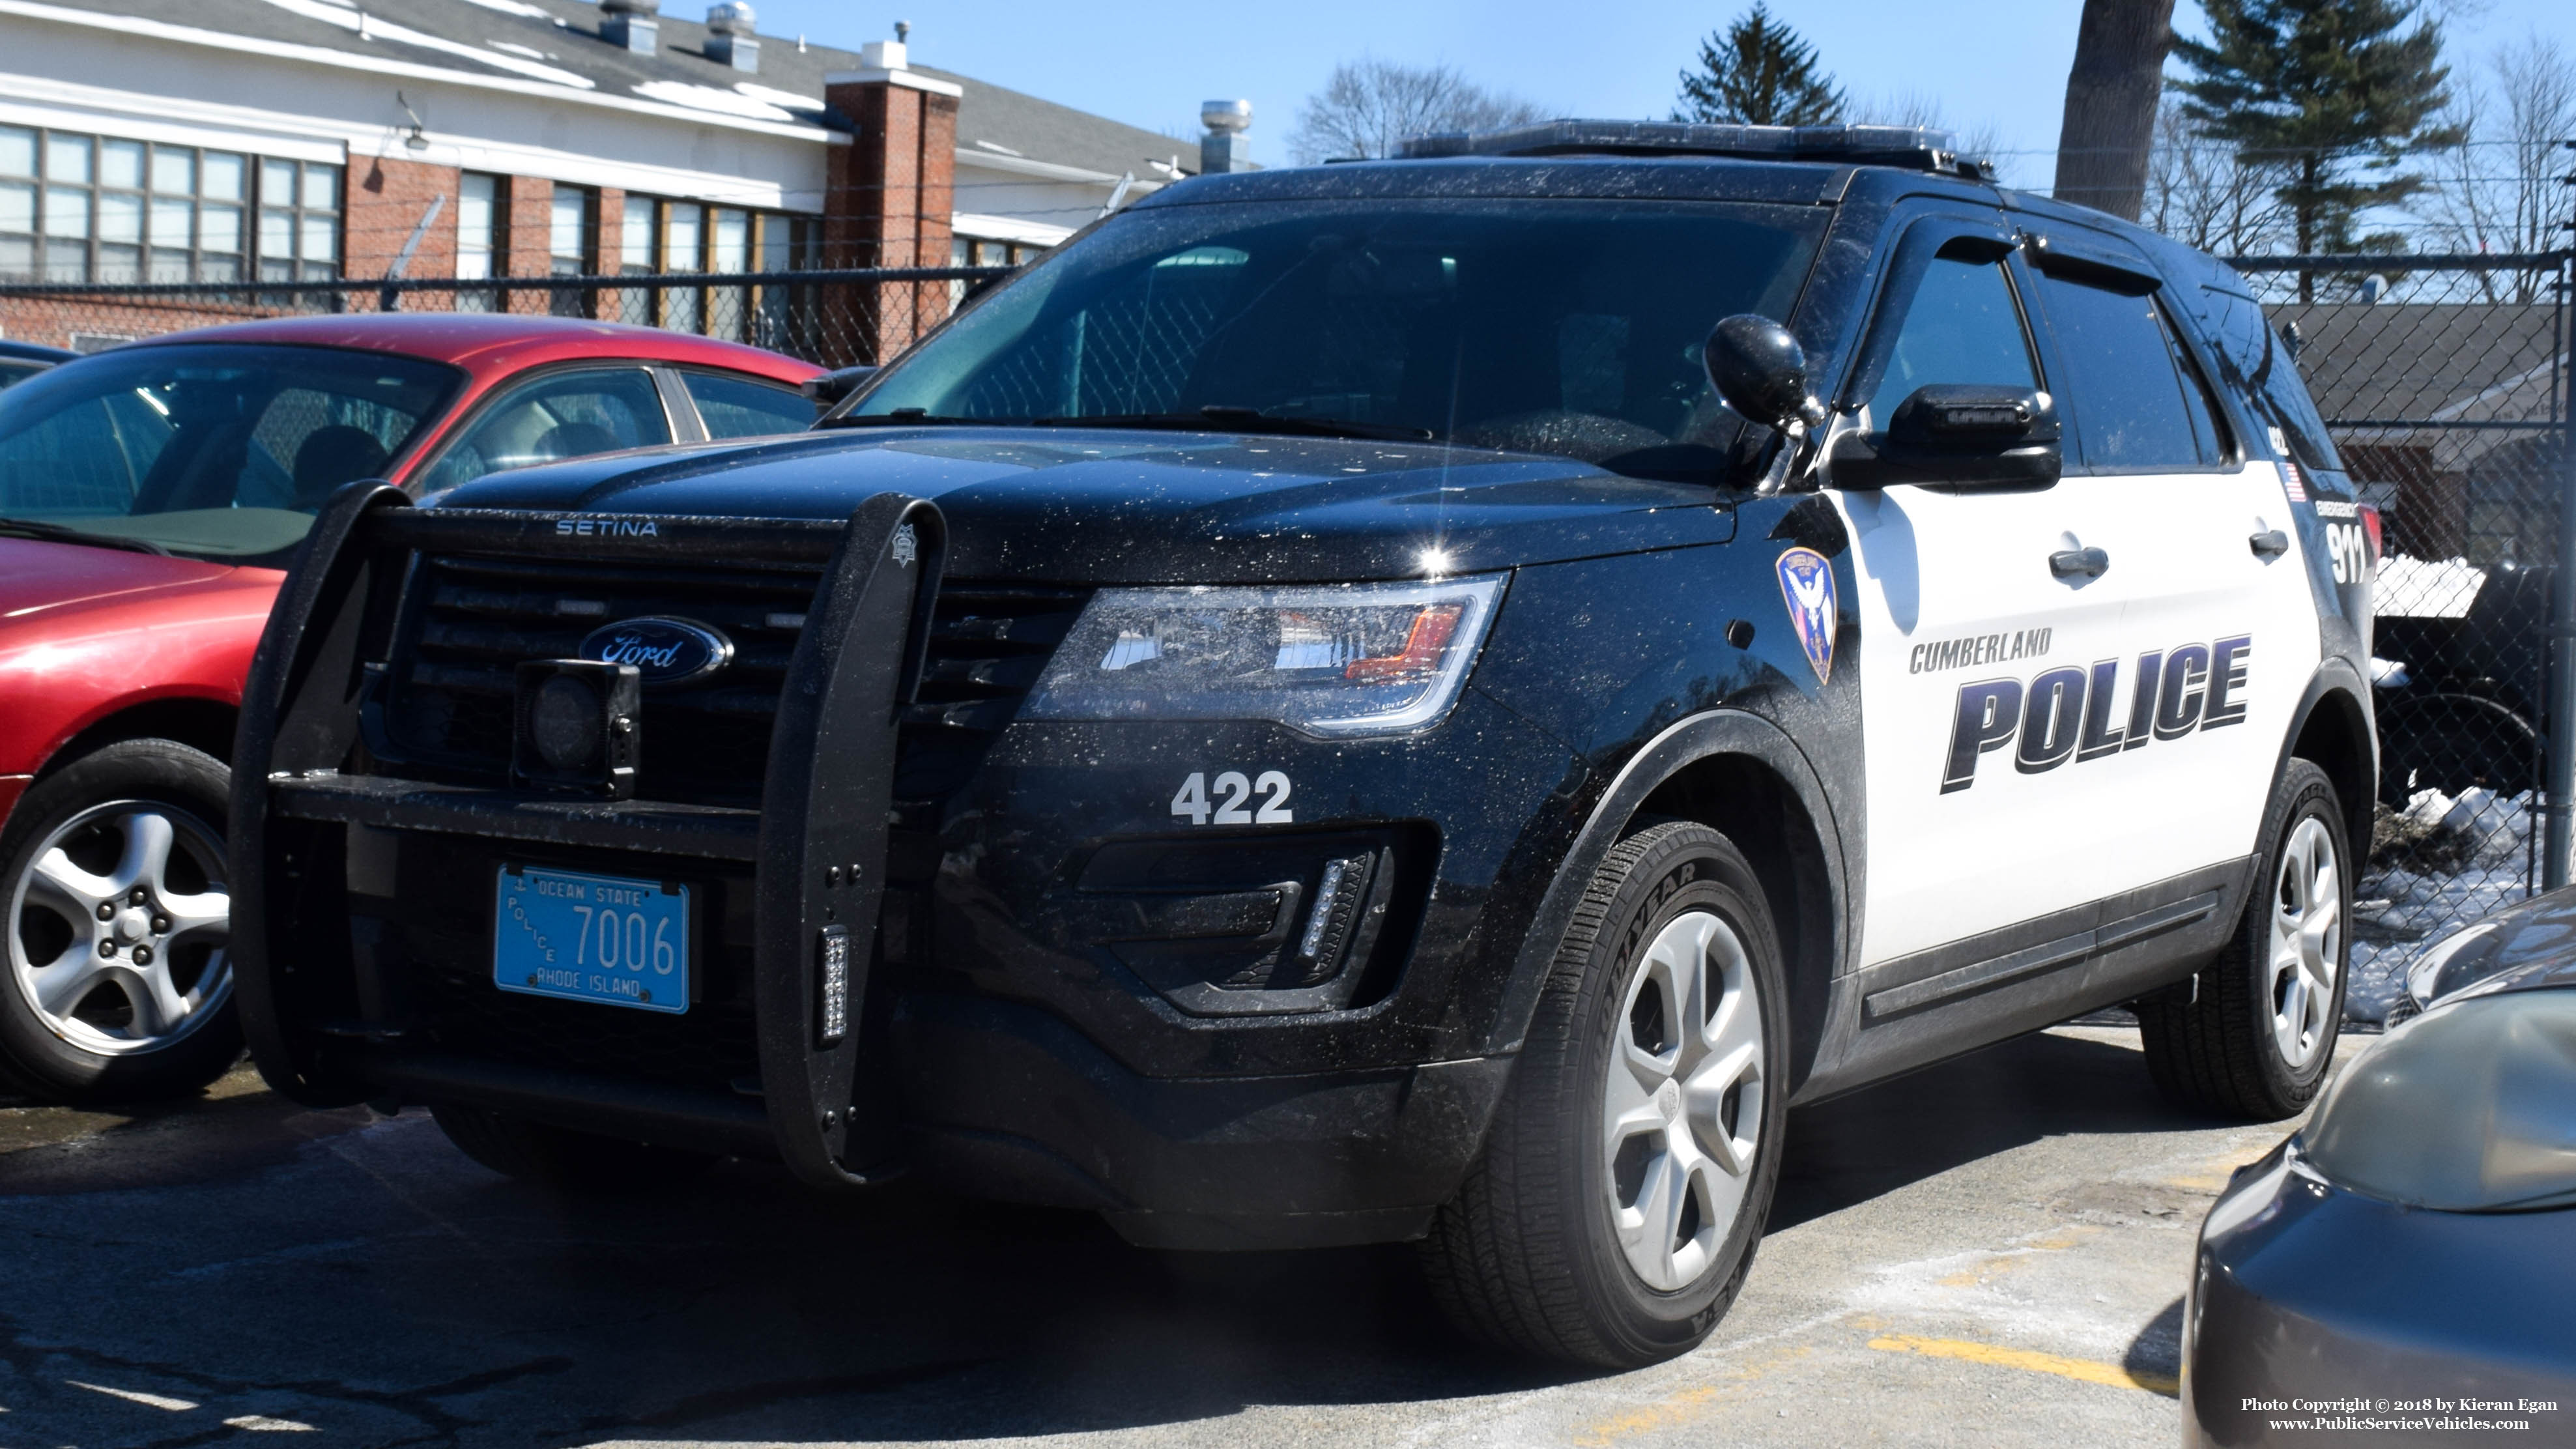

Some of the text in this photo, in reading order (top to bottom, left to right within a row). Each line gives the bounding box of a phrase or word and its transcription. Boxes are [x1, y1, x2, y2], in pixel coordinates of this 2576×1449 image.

[556, 519, 658, 538] SETINA
[2326, 523, 2366, 583] 911
[602, 633, 683, 668] Ford
[1910, 627, 2052, 674] CUMBERLAND
[1939, 633, 2252, 796] POLICE
[1171, 770, 1293, 825] 422
[538, 880, 642, 907] OCEAN STATE
[508, 897, 554, 962] POLICE
[573, 905, 674, 976] 7006
[537, 967, 640, 998] RHODE ISLAND
